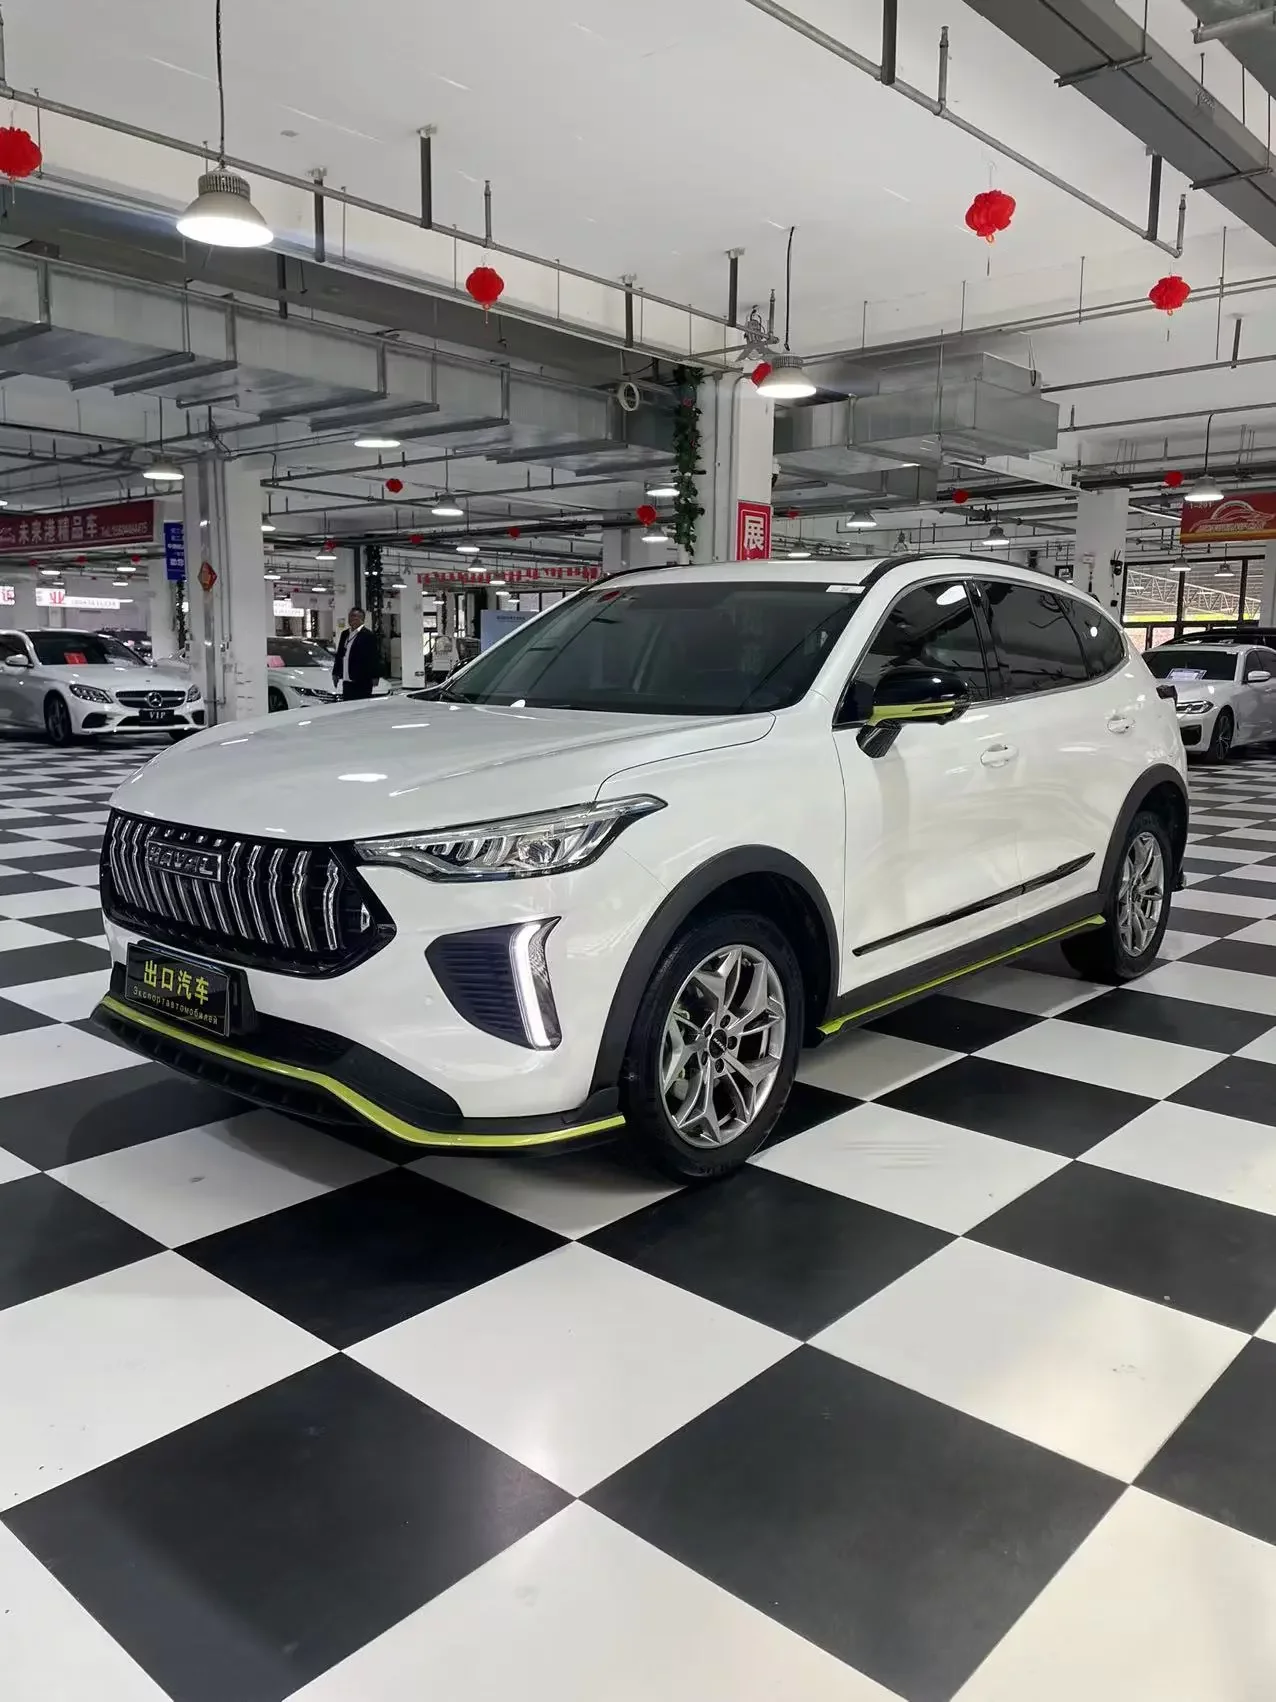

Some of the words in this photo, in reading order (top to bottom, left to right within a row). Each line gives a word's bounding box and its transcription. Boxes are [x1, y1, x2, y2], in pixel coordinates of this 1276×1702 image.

[744, 515, 764, 559] 展
[149, 711, 166, 719] VIP
[143, 960, 209, 1005] 出口汽车
